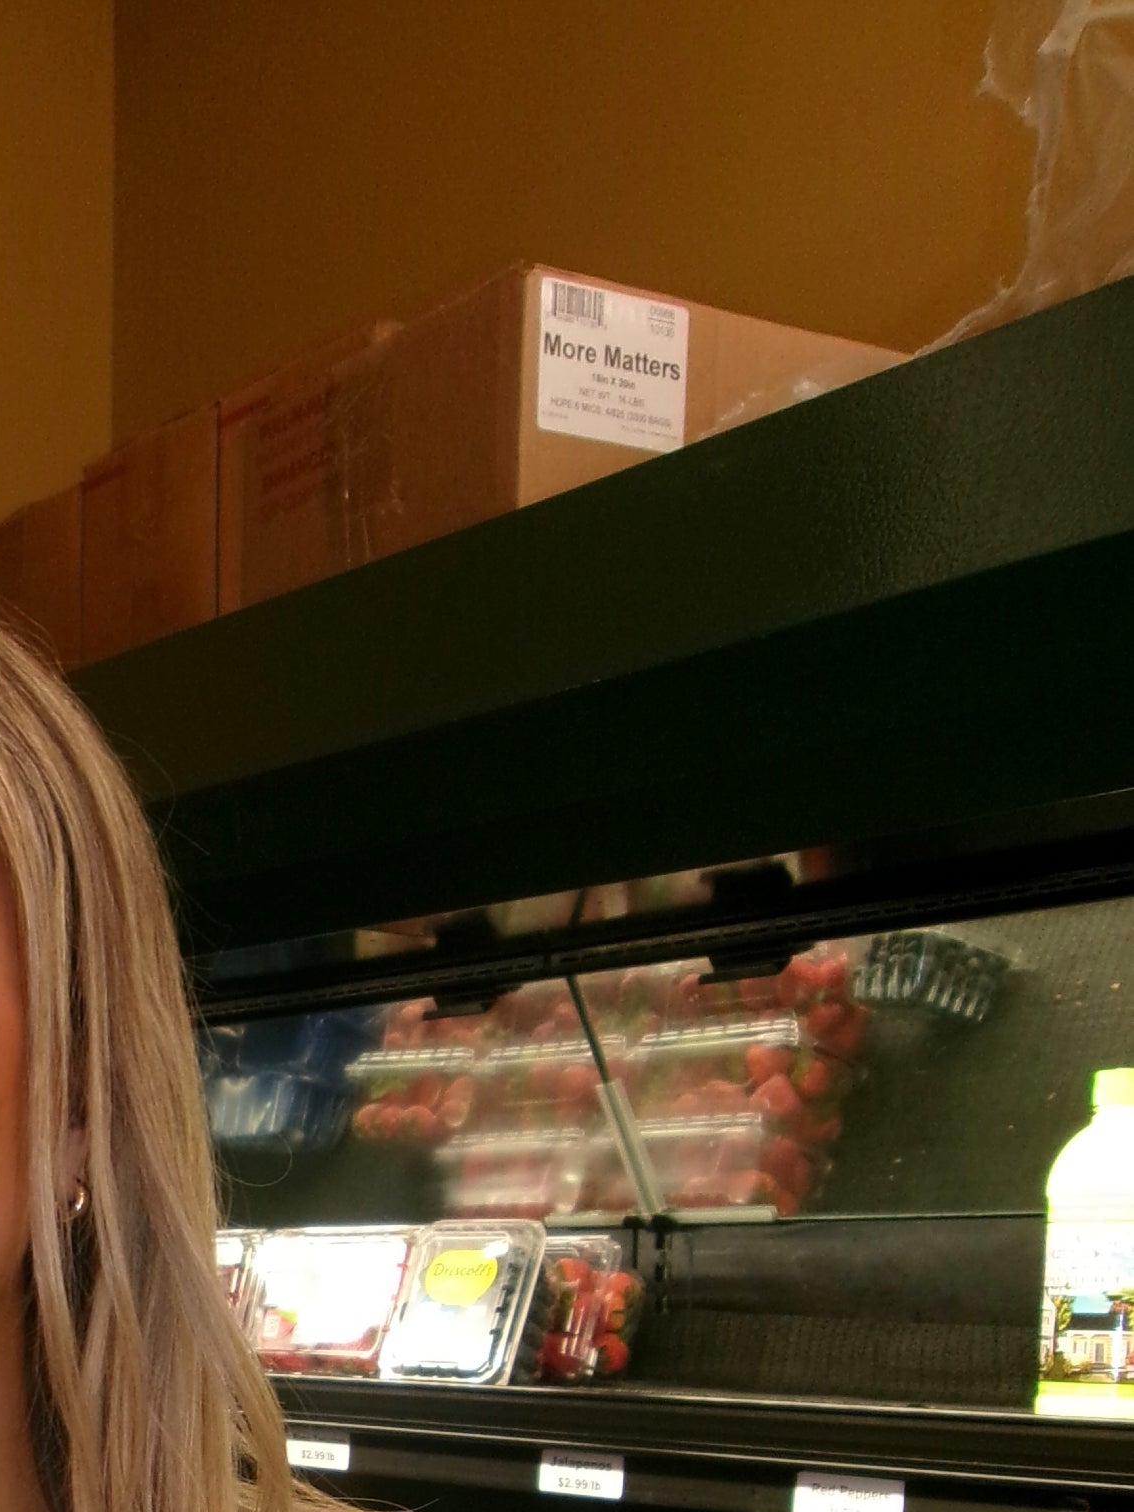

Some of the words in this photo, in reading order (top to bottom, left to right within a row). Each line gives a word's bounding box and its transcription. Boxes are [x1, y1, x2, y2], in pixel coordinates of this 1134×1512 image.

[544, 332, 597, 363] More
[605, 344, 681, 381] Matters
[811, 1482, 837, 1497] Red
